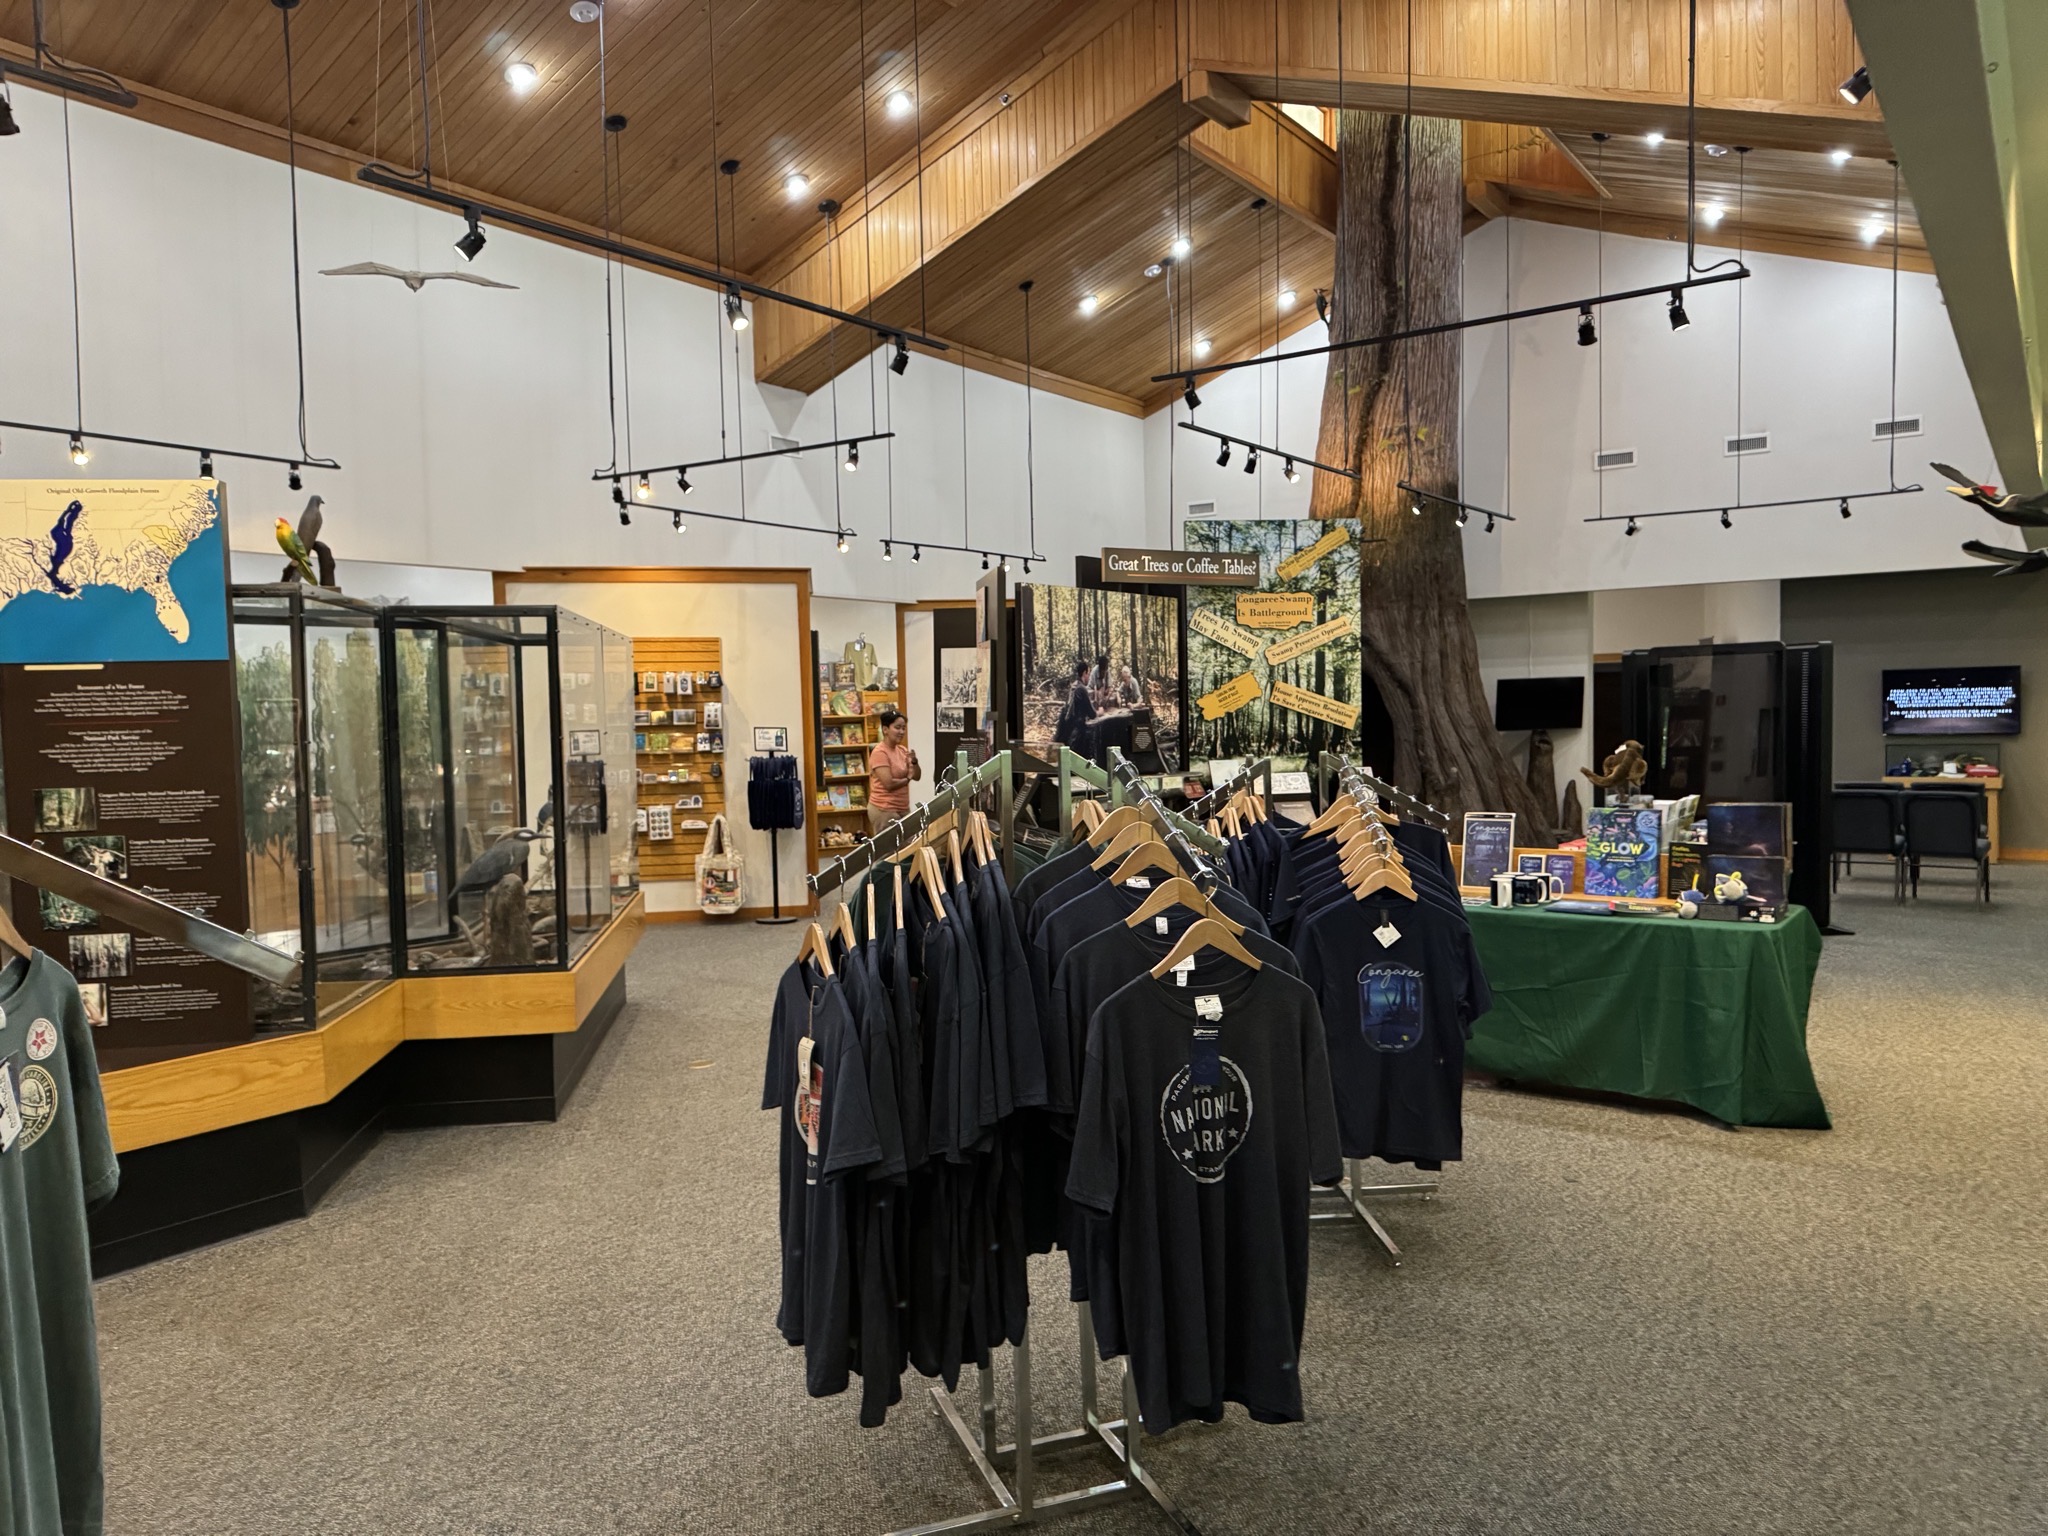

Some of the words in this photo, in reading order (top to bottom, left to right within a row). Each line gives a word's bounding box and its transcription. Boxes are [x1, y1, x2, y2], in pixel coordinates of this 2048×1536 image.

[1108, 554, 1139, 571] Great
[1141, 555, 1169, 573] Trees
[1172, 562, 1184, 573] or
[1186, 558, 1220, 574] Coffee
[1222, 559, 1257, 576] Tables?
[1236, 594, 1279, 605] Congaree
[1280, 594, 1312, 604] Swamp
[1237, 608, 1246, 617] Is
[1250, 608, 1308, 618] Battleground
[1191, 619, 1208, 633] May
[1210, 629, 1229, 644] Face
[1230, 640, 1249, 654] Axes
[1198, 608, 1218, 626] Trees
[1220, 620, 1230, 632] In
[1232, 627, 1260, 648] Swamp
[1271, 646, 1294, 658] Swamp
[1294, 634, 1320, 648] Preserve
[1321, 621, 1347, 636] Opposed
[1295, 694, 1320, 708] Approves
[1322, 704, 1353, 719] Resolution
[1297, 704, 1324, 718] Congaree
[1326, 713, 1346, 726] Swamp
[1468, 822, 1509, 837] Congaree
[1600, 842, 1644, 855] GLOW
[1356, 962, 1424, 989] Congaree
